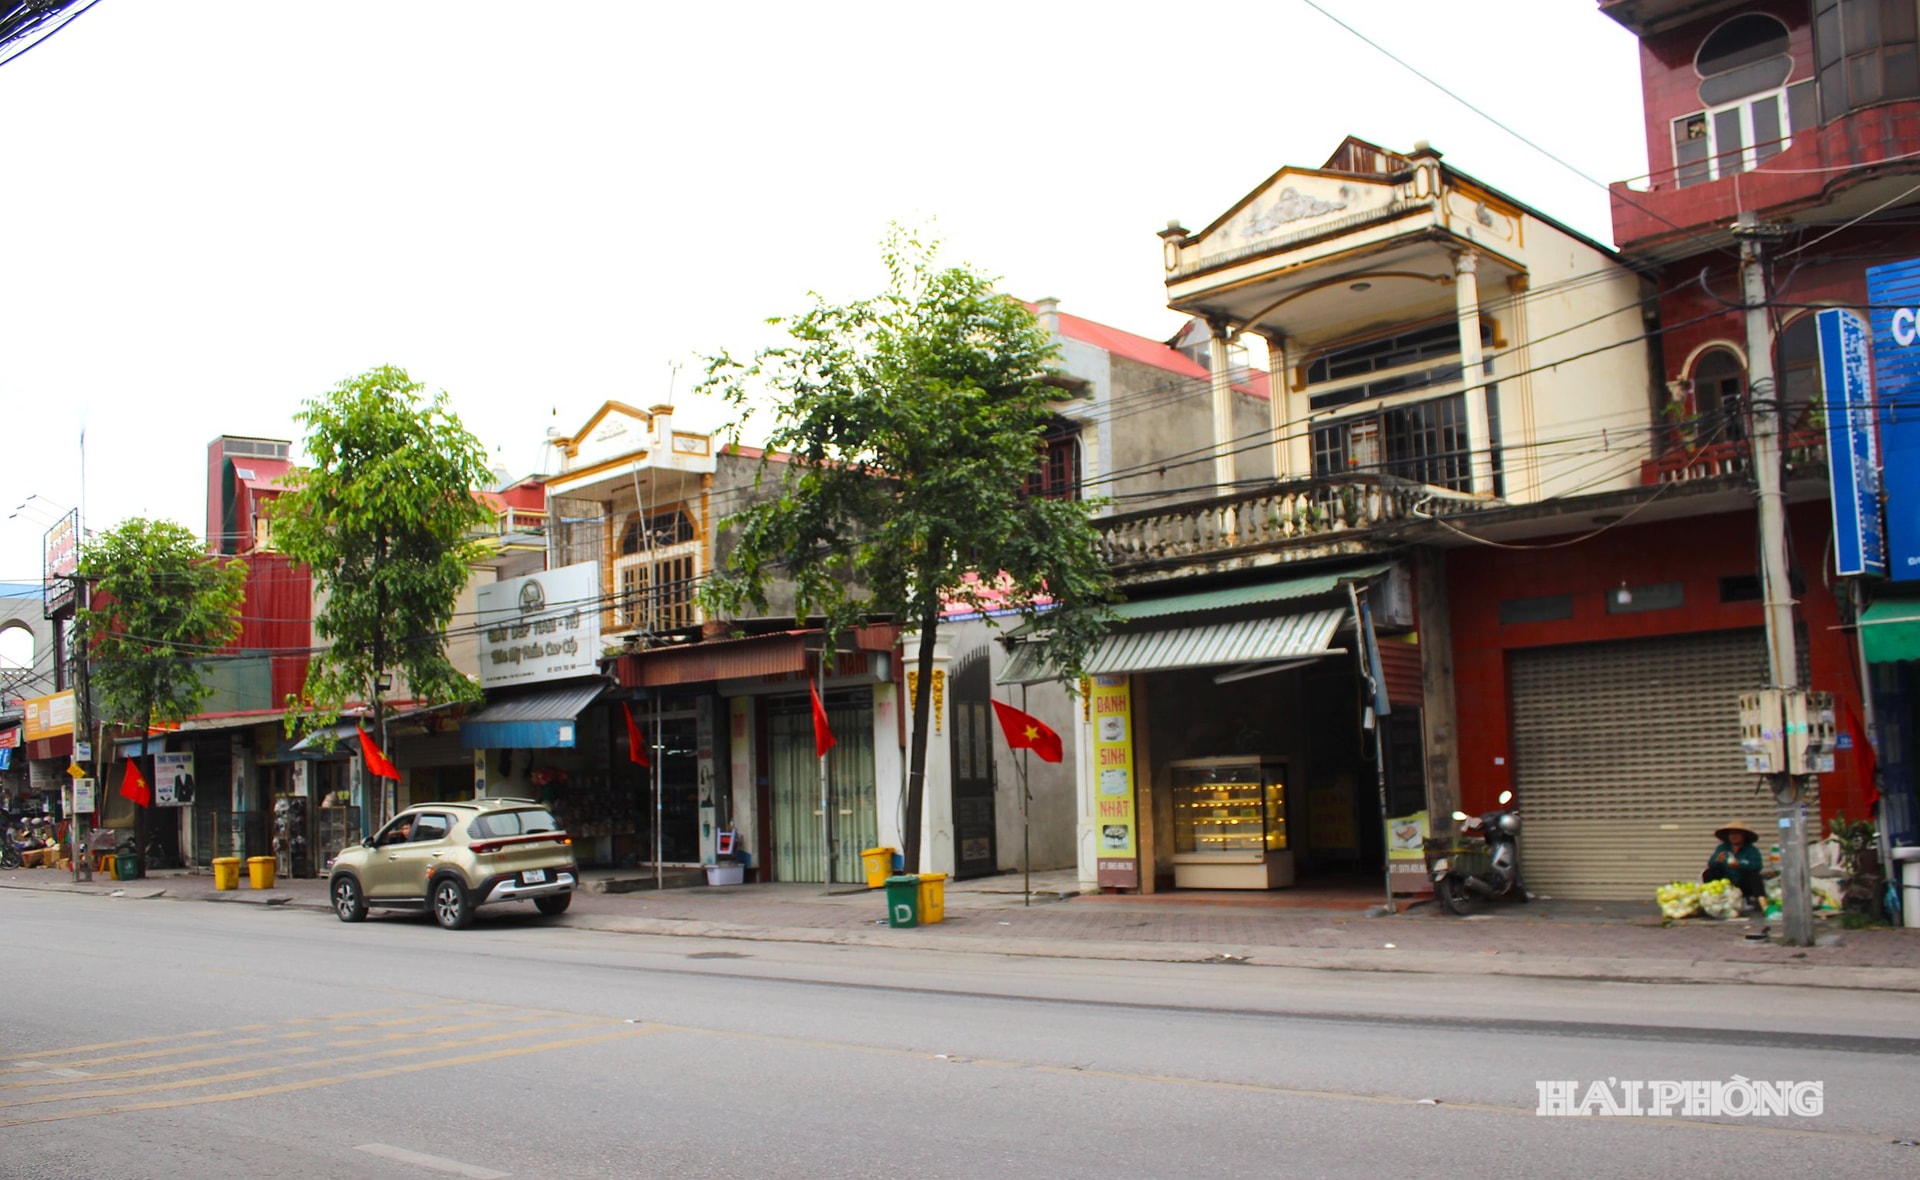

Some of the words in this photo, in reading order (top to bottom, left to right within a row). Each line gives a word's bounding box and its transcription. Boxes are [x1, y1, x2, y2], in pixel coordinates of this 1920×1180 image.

[1892, 307, 1920, 346] C
[1100, 747, 1127, 766] SINH
[894, 904, 912, 923] D
